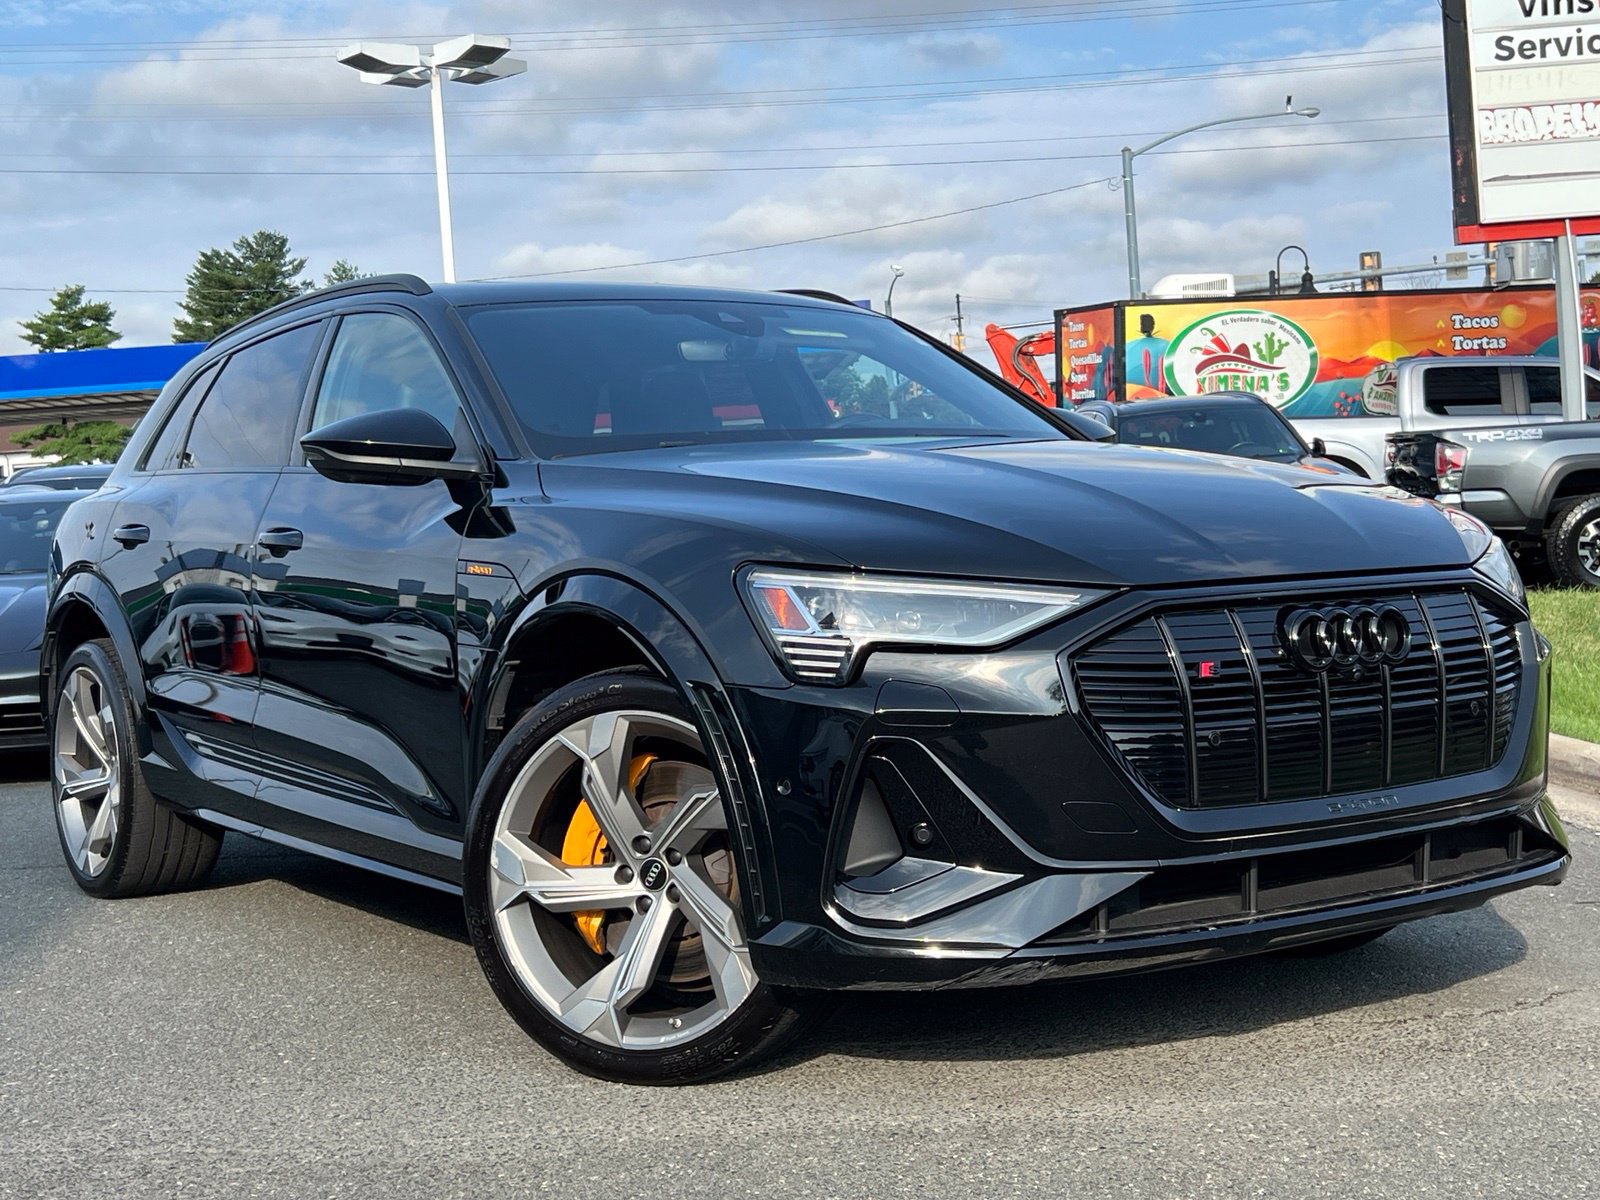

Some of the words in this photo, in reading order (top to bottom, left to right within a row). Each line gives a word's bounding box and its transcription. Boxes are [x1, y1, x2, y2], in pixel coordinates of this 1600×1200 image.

[1069, 321, 1085, 333] Tacos
[1451, 314, 1499, 329] Tacos
[1069, 338, 1088, 349] Tortas
[1451, 335, 1507, 350] Tortas
[1070, 371, 1088, 384] Sopes
[1196, 372, 1290, 394] XIMENA'S
[1071, 387, 1096, 400] Burritos
[1462, 430, 1505, 443] TRD
